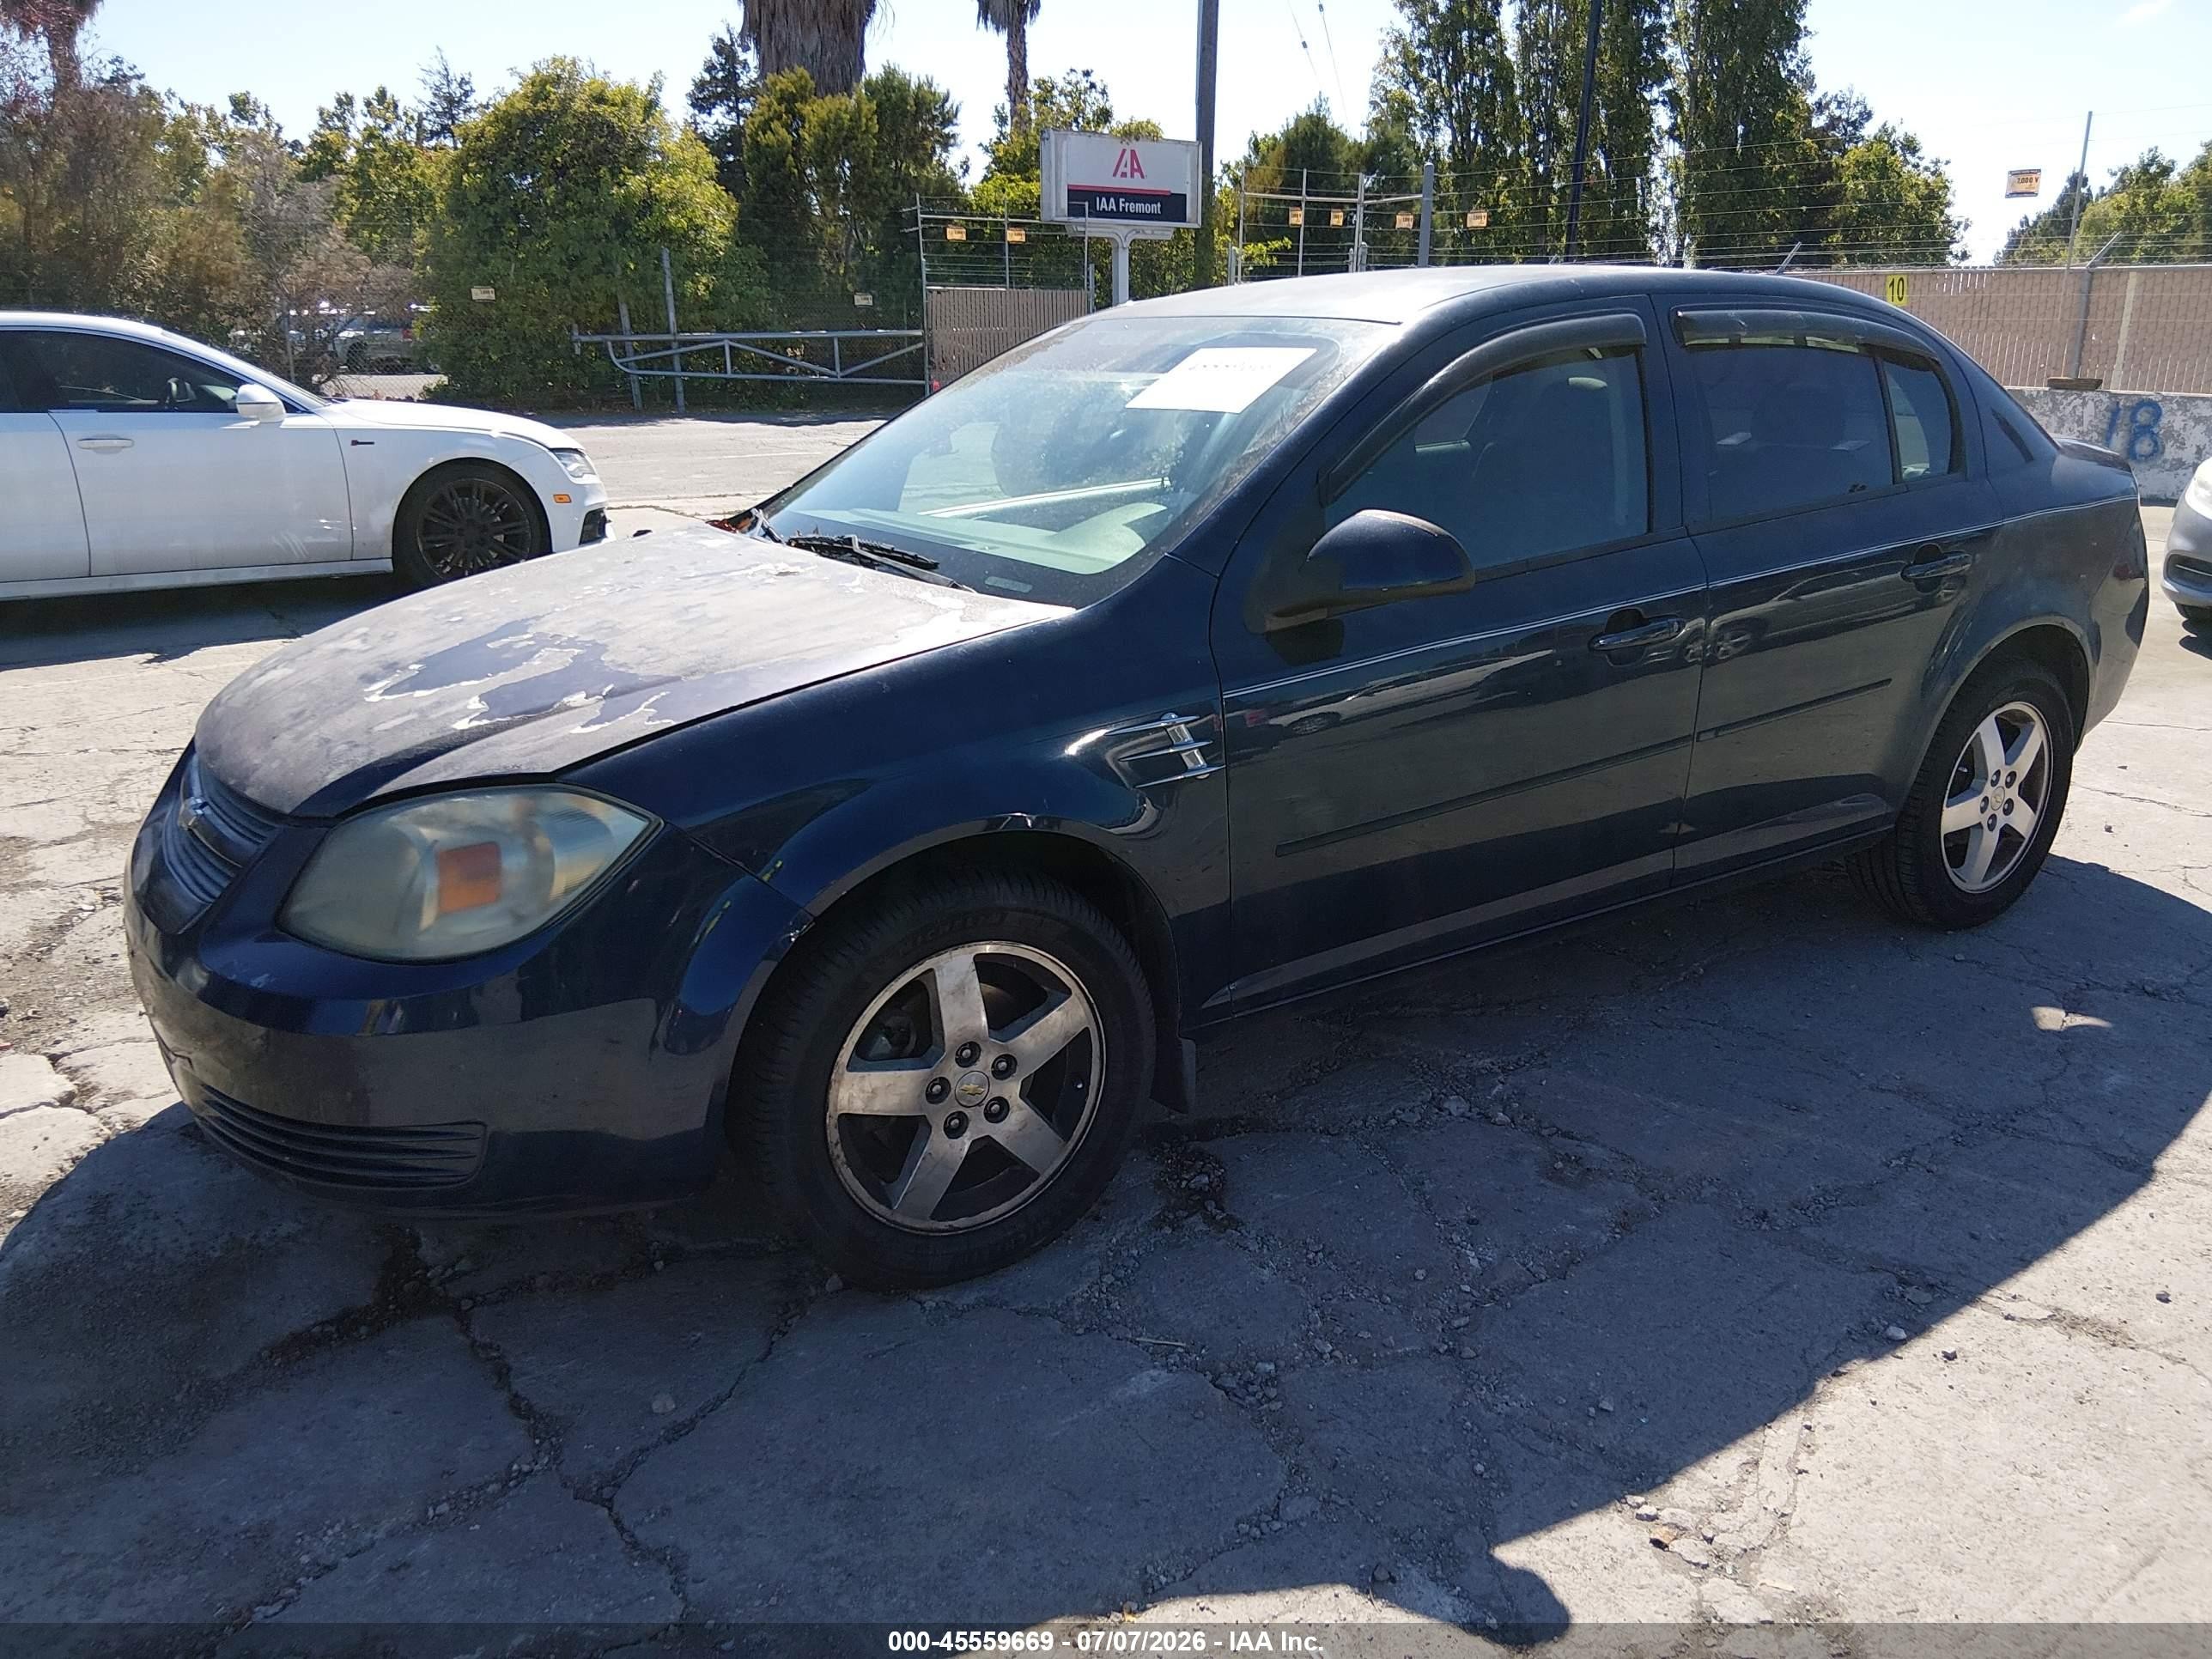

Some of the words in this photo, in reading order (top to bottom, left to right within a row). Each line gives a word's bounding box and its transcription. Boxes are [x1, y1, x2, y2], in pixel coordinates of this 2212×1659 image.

[1096, 196, 1116, 212] IAA
[1119, 198, 1162, 215] Fremont
[1889, 276, 1905, 303] 10
[2105, 398, 2163, 461] 18
